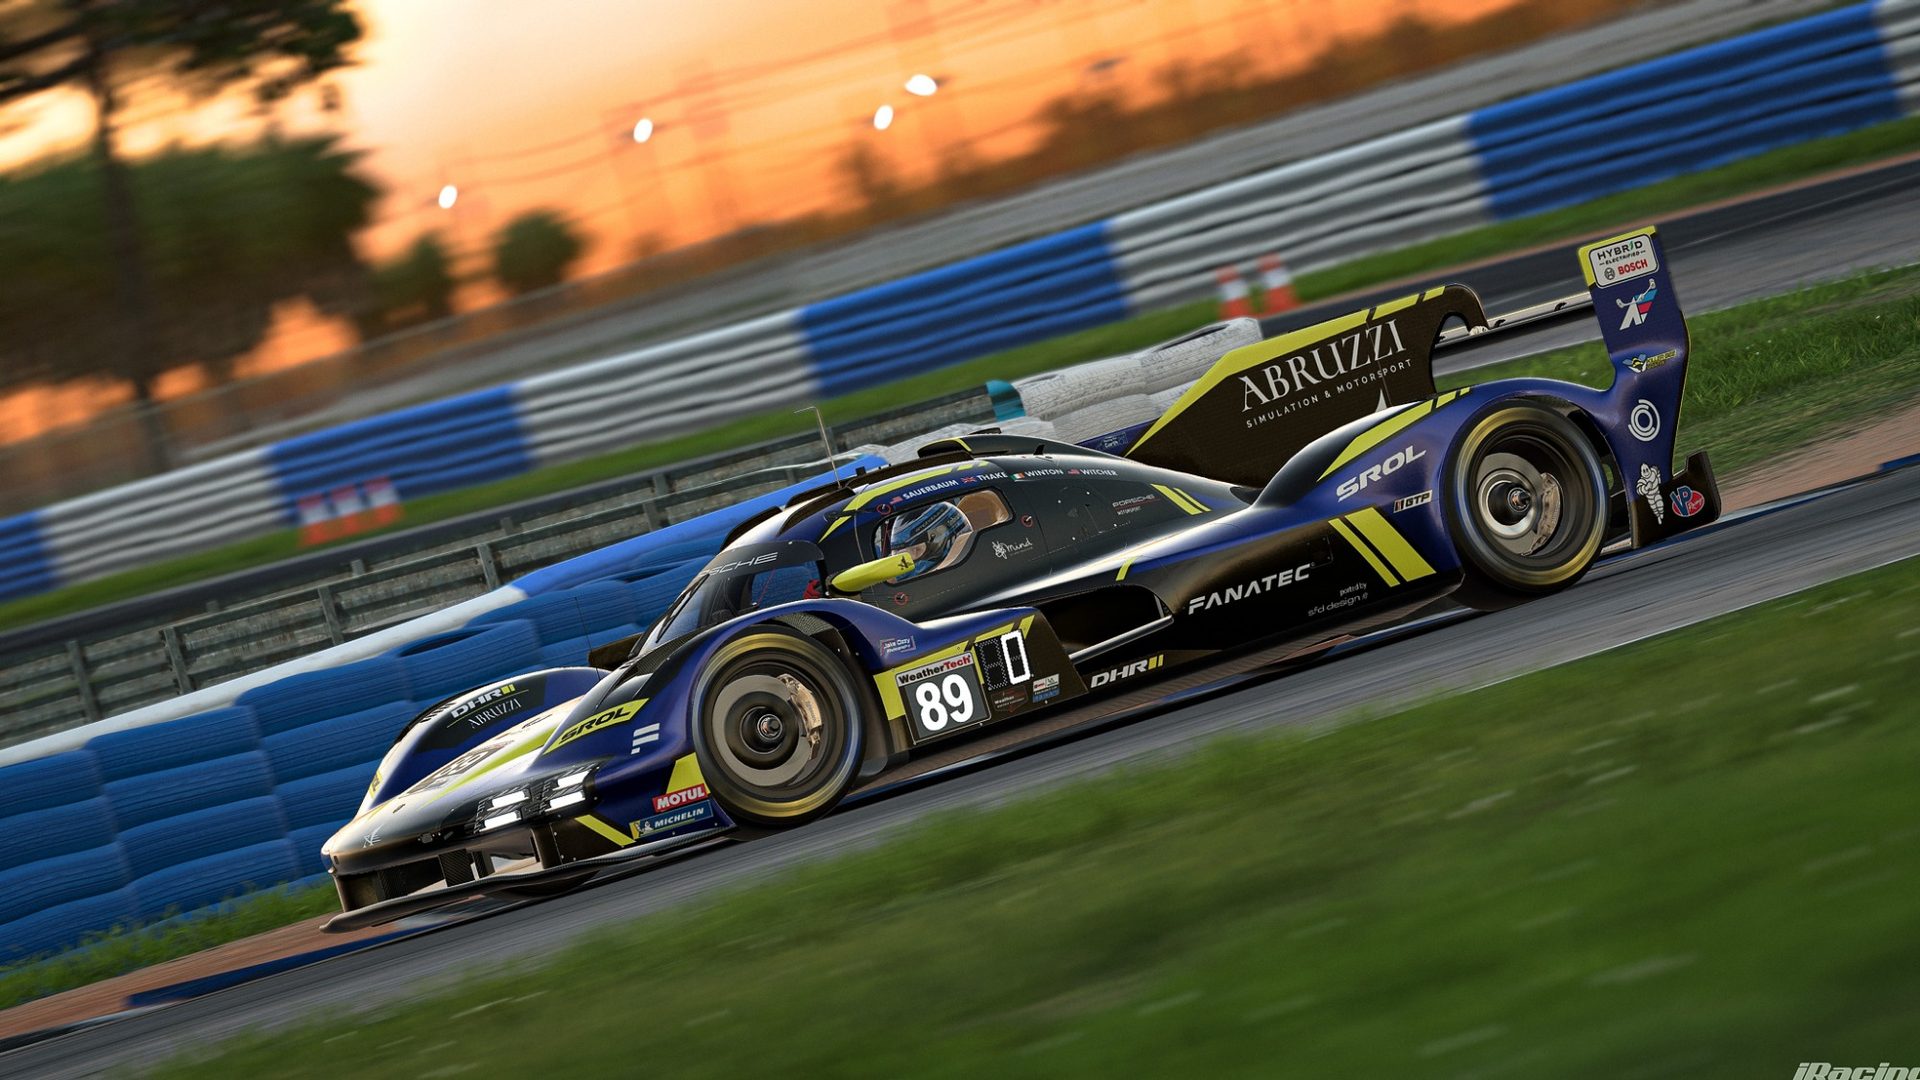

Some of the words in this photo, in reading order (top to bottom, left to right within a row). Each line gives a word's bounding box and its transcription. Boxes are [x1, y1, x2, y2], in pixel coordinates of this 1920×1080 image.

[1597, 241, 1643, 260] HYBRID
[1605, 251, 1640, 265] ELECTRIFIED
[1618, 259, 1648, 275] BOSCH
[1238, 319, 1406, 412] ABRUZZI
[1246, 394, 1319, 428] SIMULATION
[1324, 389, 1332, 398] &
[1337, 359, 1412, 393] MOTORSPORT
[902, 479, 960, 501] SAUERBAUM
[977, 471, 1008, 481] THAKE
[1025, 469, 1064, 477] WINTON
[1336, 445, 1427, 503] SROL
[1112, 494, 1155, 508] PORSCHE
[1405, 492, 1431, 508] GTP
[1188, 563, 1311, 615] FANATEC
[1326, 593, 1361, 611] design
[1339, 583, 1359, 597] ported
[1359, 582, 1367, 592] by
[898, 655, 971, 684] WeatherTech
[468, 698, 522, 729] ABRUZZI
[915, 673, 975, 732] 89
[559, 708, 631, 745] SROL
[657, 786, 705, 809] MOTUL
[654, 808, 704, 828] MICHELIN
